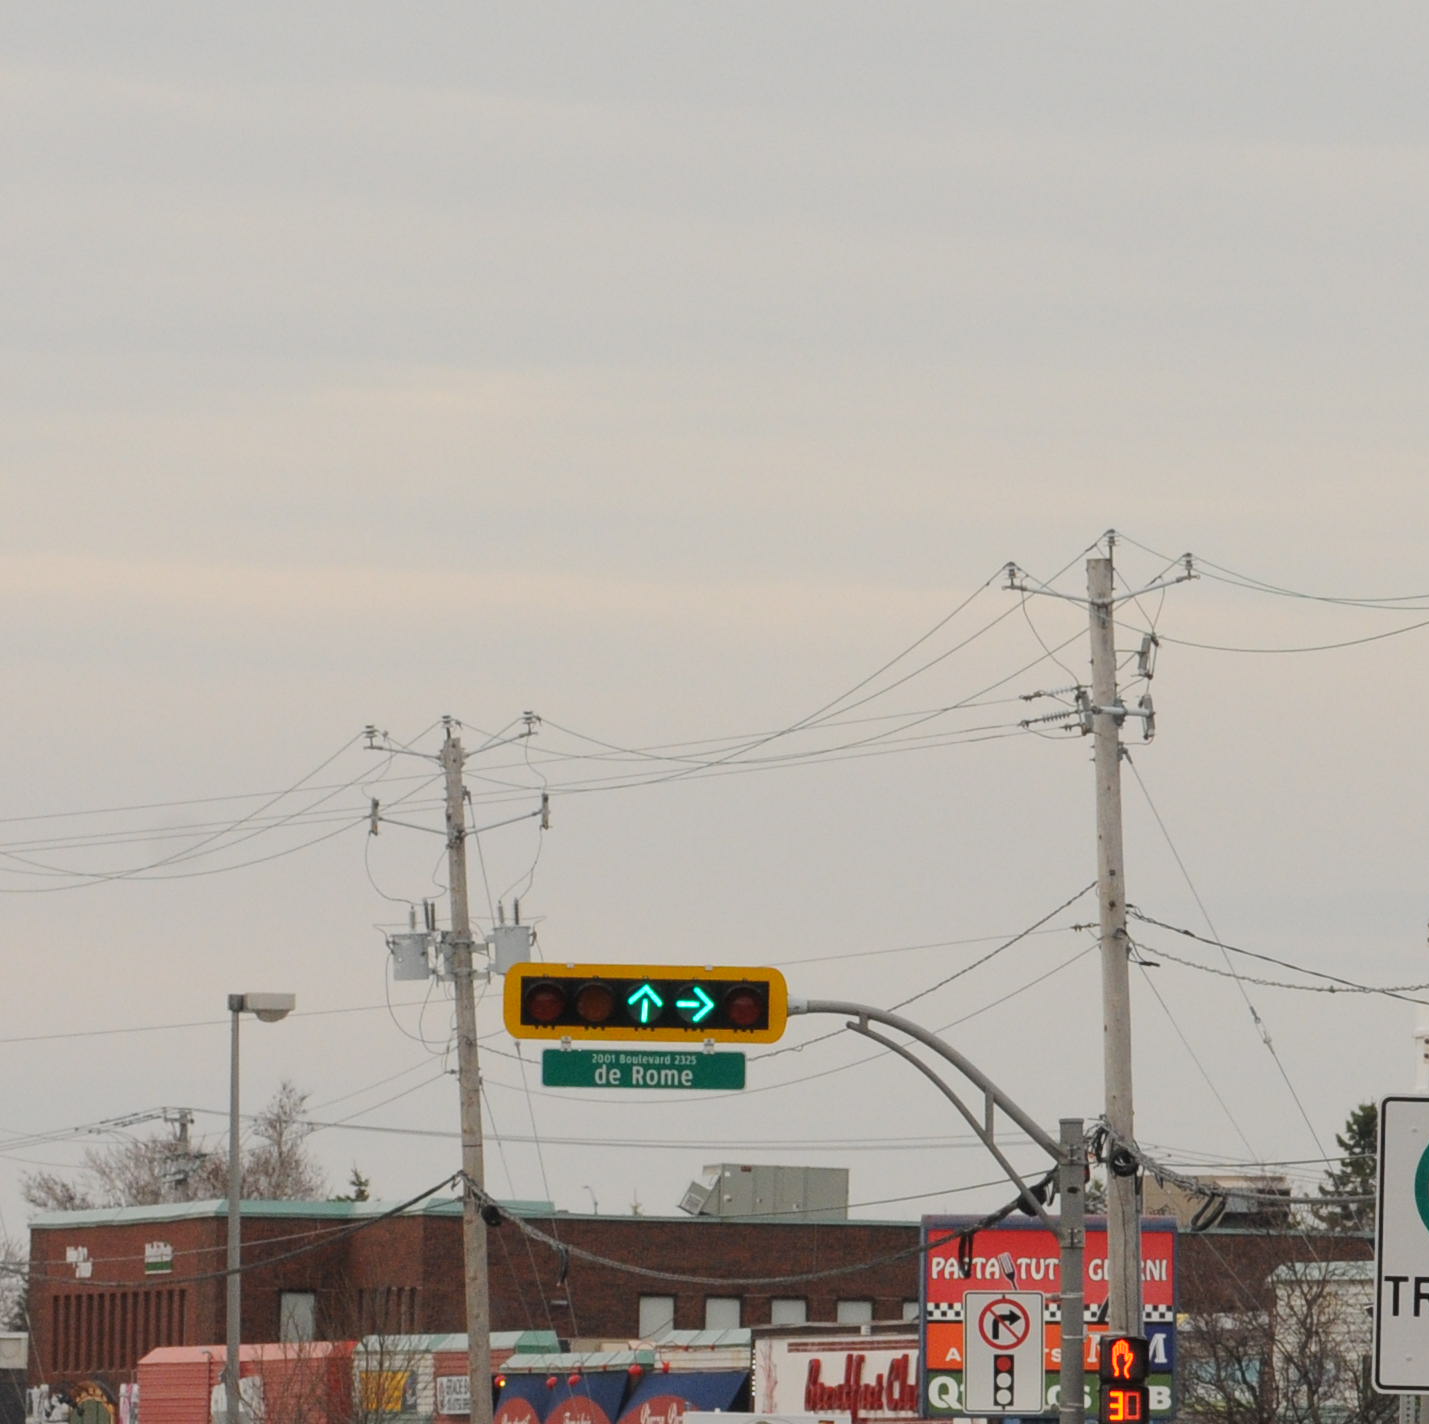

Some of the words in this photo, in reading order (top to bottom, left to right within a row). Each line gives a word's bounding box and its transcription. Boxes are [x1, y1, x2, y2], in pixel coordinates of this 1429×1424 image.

[592, 1053, 616, 1064] 2001
[619, 1053, 671, 1065] Boulevard
[674, 1055, 697, 1065] 2325
[595, 1064, 621, 1085] de
[632, 1065, 693, 1086] Rome
[1109, 1390, 1141, 1422] 30
